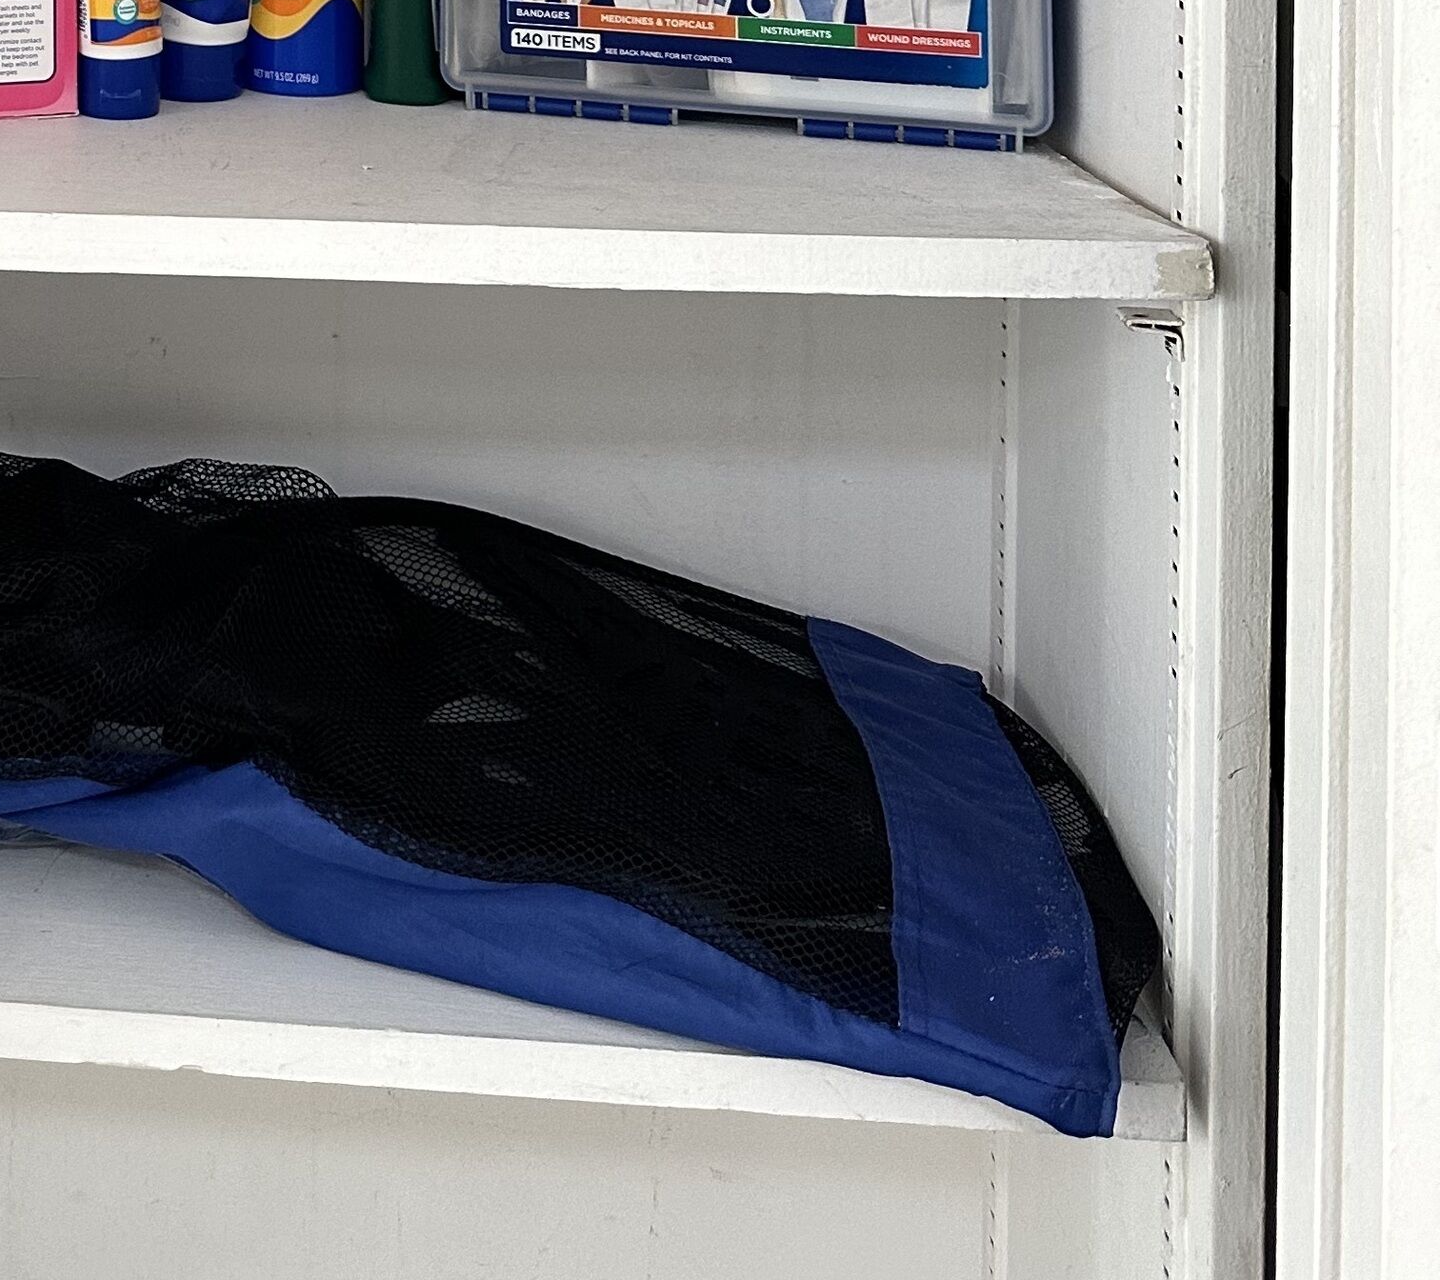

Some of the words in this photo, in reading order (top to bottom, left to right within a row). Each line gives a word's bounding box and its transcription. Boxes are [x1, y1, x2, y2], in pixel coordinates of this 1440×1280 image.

[516, 8, 571, 20] BANDAGES
[601, 13, 654, 26] MEDICINES
[656, 17, 663, 26] &
[665, 18, 714, 30] TOPICALS
[760, 25, 832, 39] INSTRUMENTS
[515, 32, 543, 46] 140
[548, 34, 596, 51] ITEMS
[867, 33, 910, 44] WOUND
[912, 35, 971, 48] DRESSINGS
[619, 48, 639, 56] BACK
[640, 49, 663, 58] PANEL
[664, 51, 680, 59] FOR
[693, 53, 733, 64] CONTENTS
